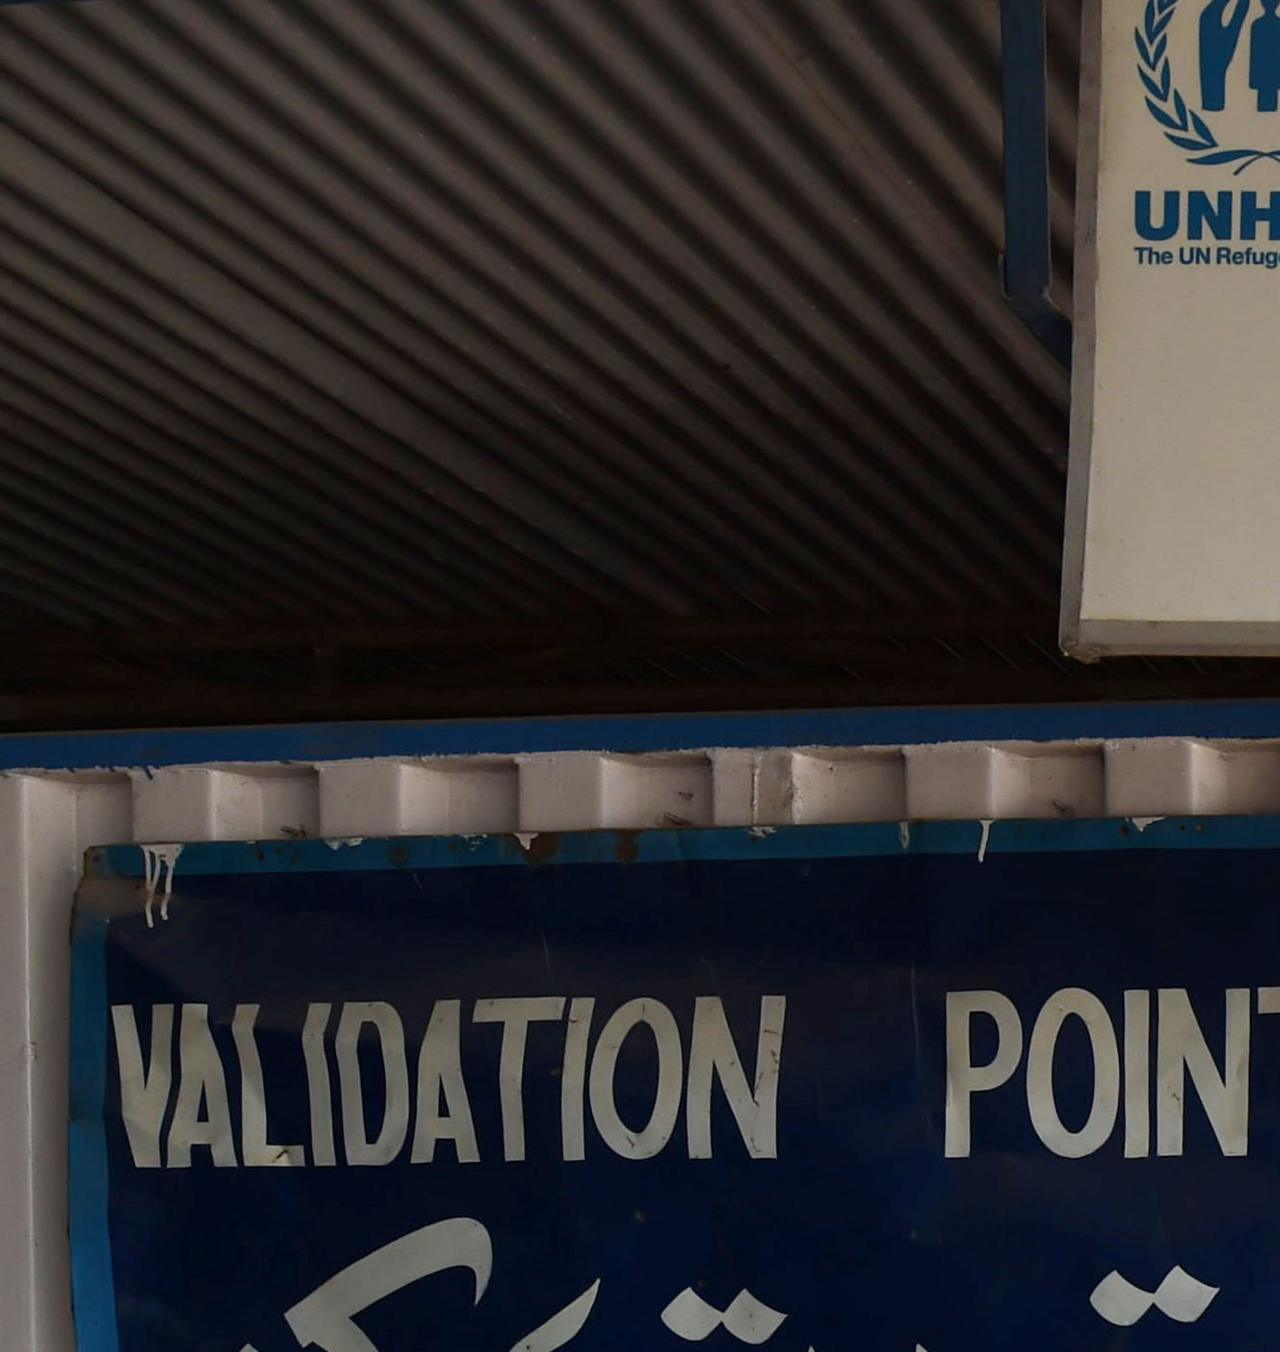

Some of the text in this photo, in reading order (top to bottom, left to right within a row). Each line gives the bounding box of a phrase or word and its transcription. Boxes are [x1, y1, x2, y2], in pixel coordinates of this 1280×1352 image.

[1134, 247, 1173, 265] The
[1179, 247, 1211, 265] UN
[111, 996, 787, 1168] VALIDATION
